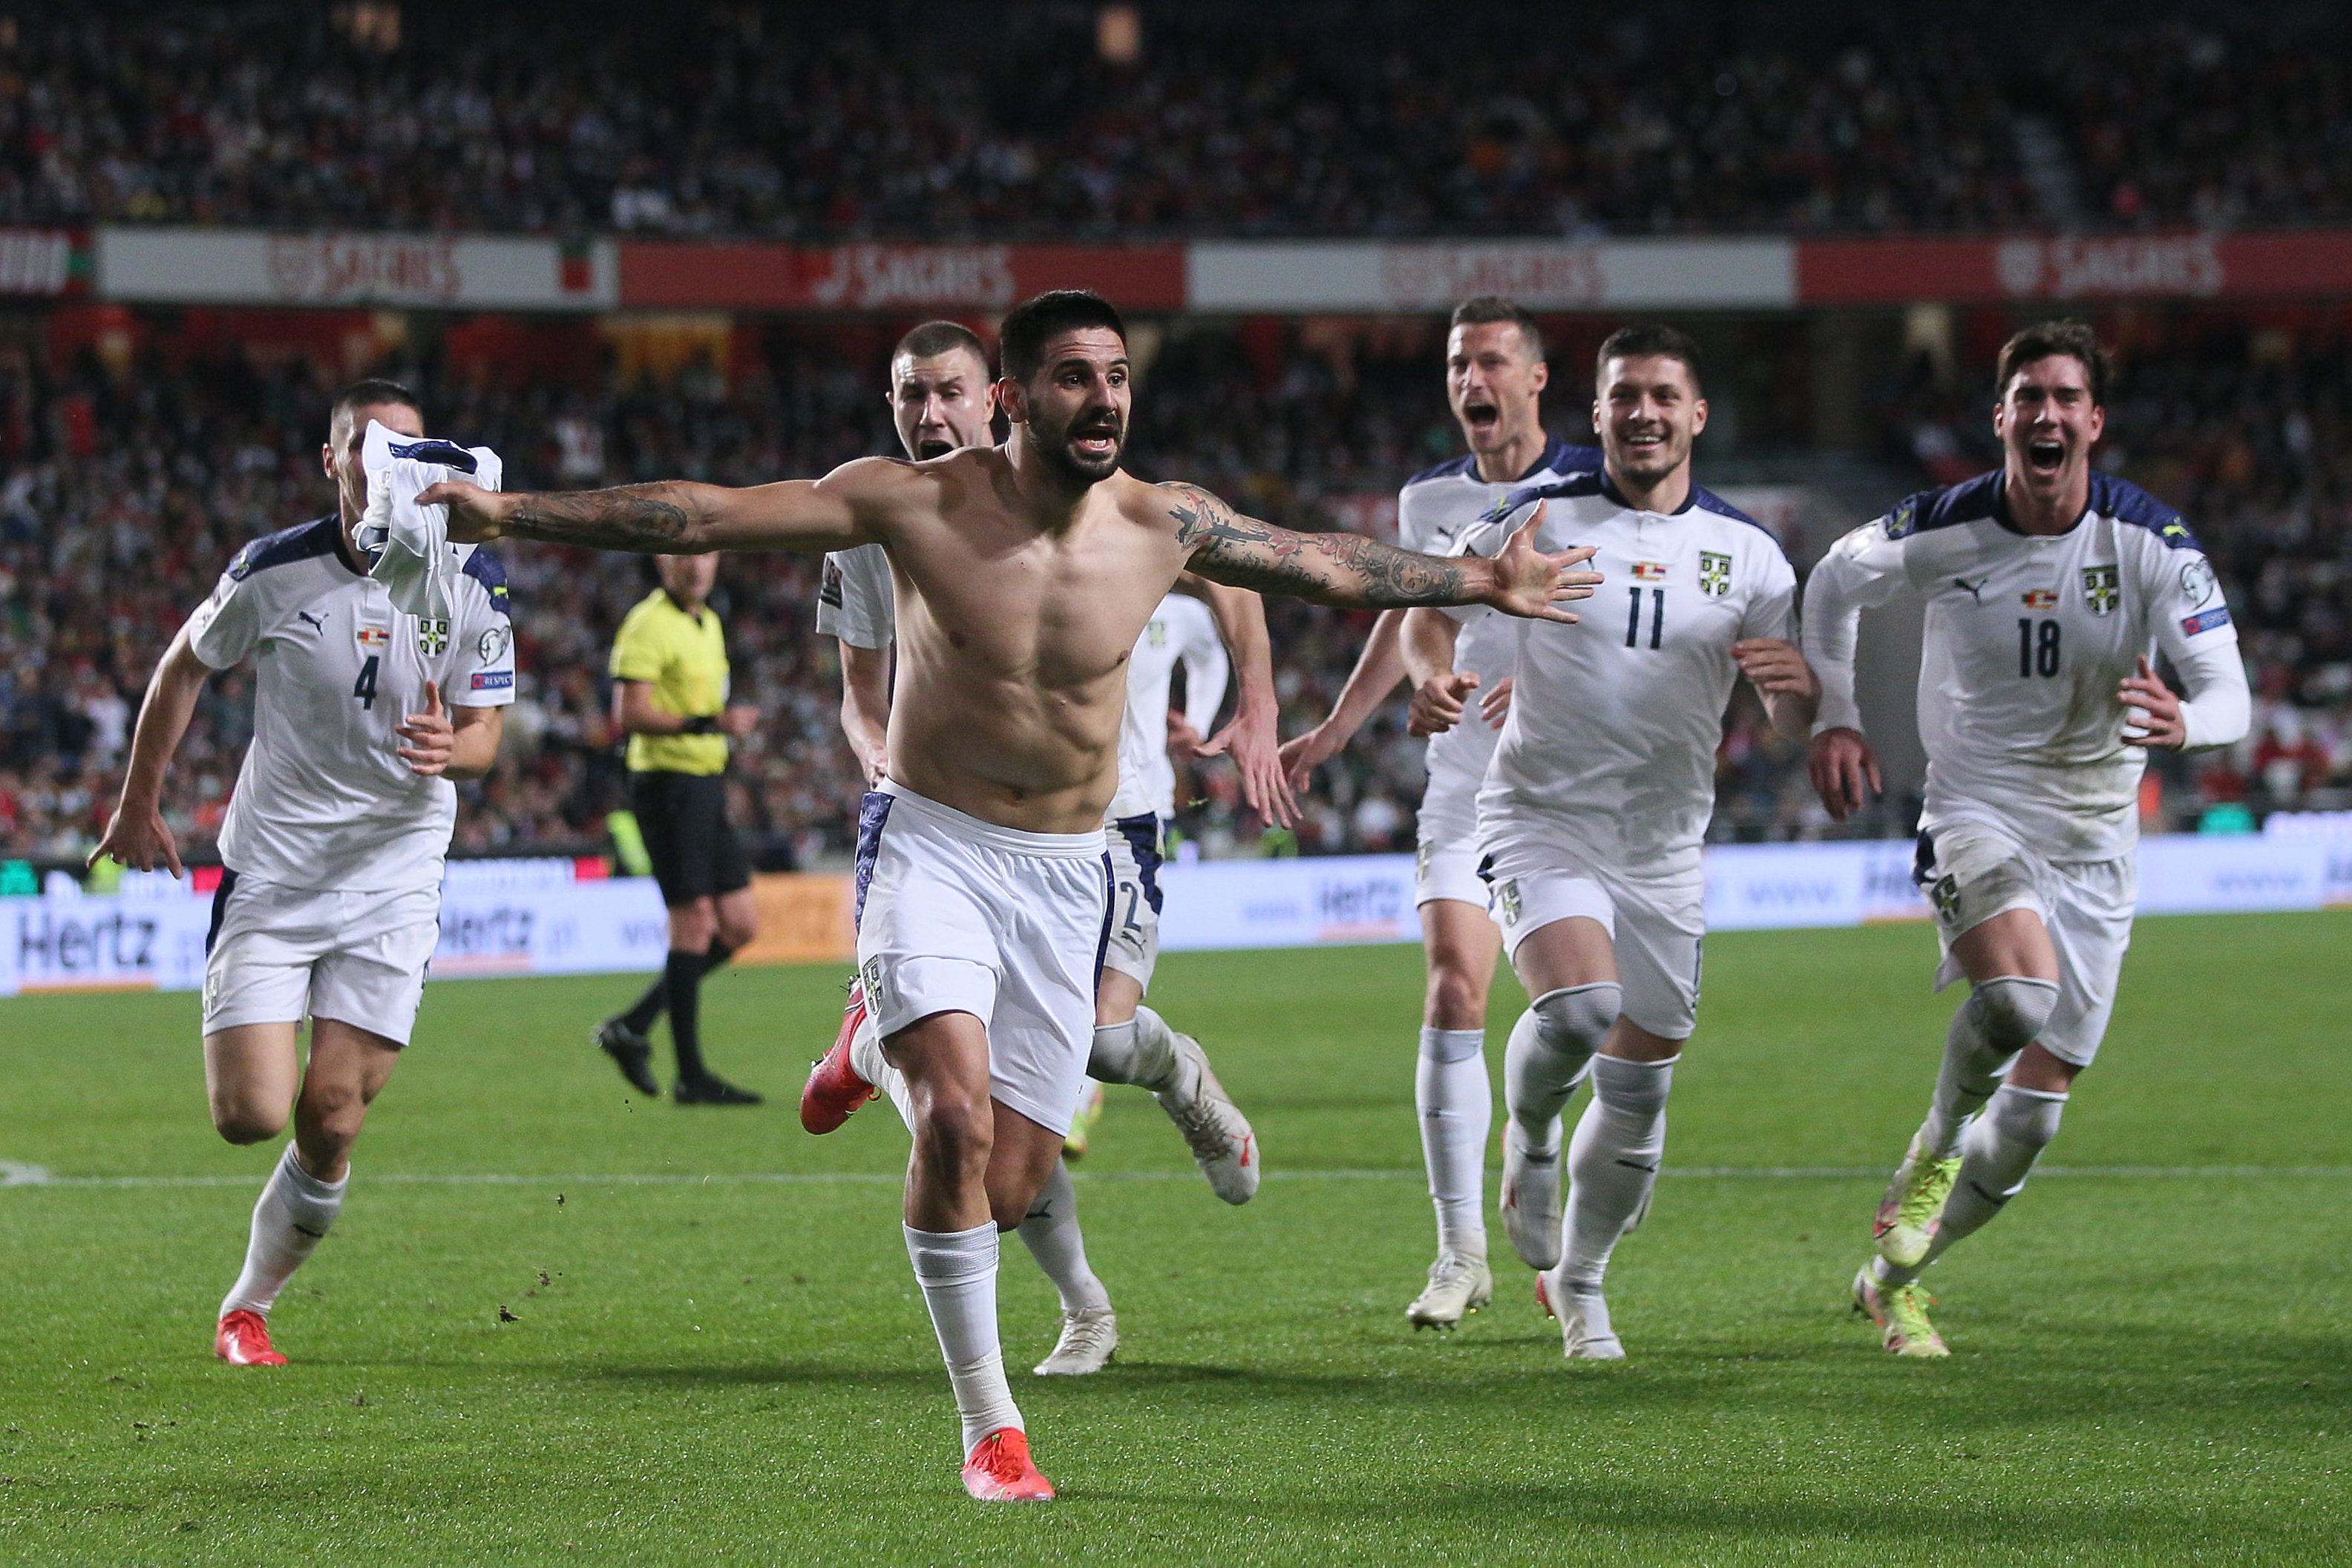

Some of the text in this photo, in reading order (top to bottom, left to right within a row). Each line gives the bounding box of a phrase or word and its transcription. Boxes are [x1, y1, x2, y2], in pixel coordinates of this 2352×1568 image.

[1625, 586, 1664, 649] 11
[2018, 618, 2060, 678] 18
[354, 655, 380, 710] 4
[1120, 881, 1141, 932] 2
[18, 911, 156, 969] Hertz
